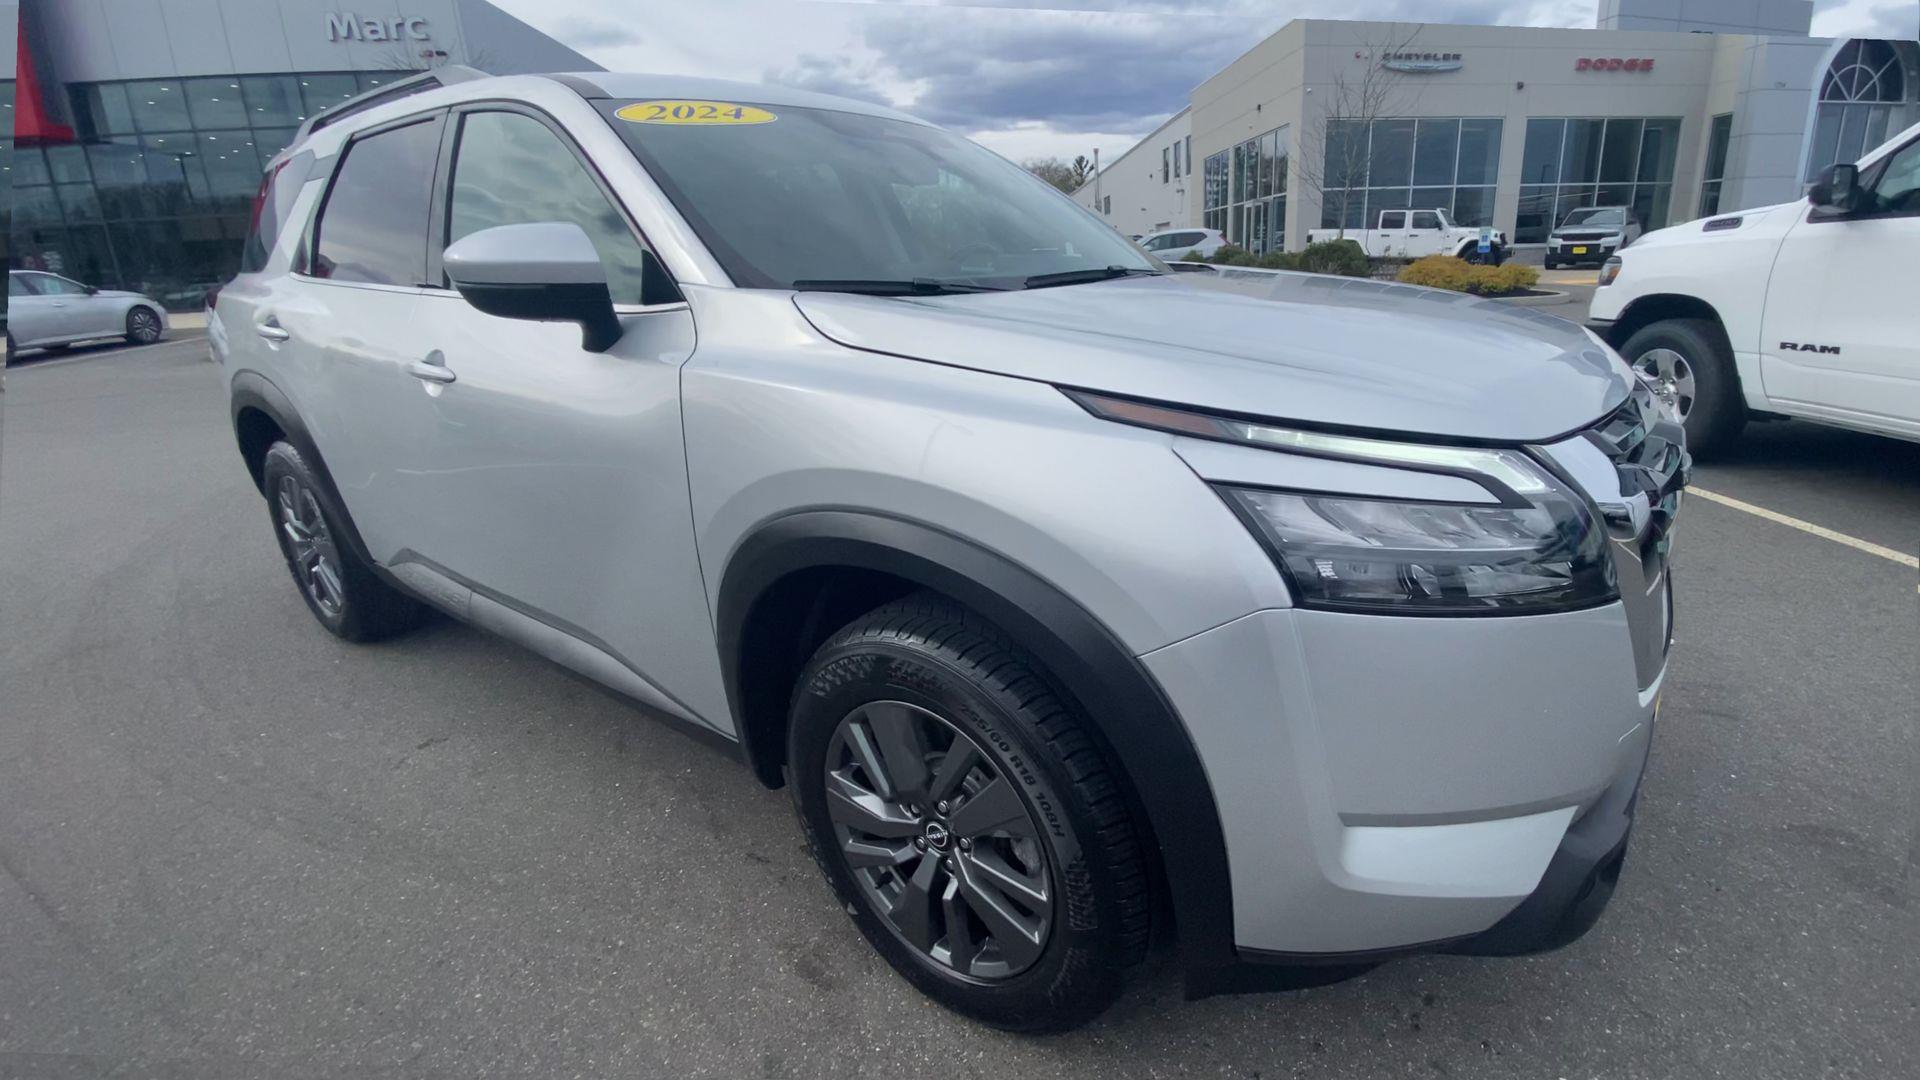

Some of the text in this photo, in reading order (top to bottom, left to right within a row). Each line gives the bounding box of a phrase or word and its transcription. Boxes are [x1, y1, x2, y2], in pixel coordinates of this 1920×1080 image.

[325, 12, 430, 42] Marc
[1575, 57, 1655, 73] DODGE
[645, 104, 744, 121] 2024
[1780, 341, 1841, 355] RAM
[1009, 755, 1037, 786] R18
